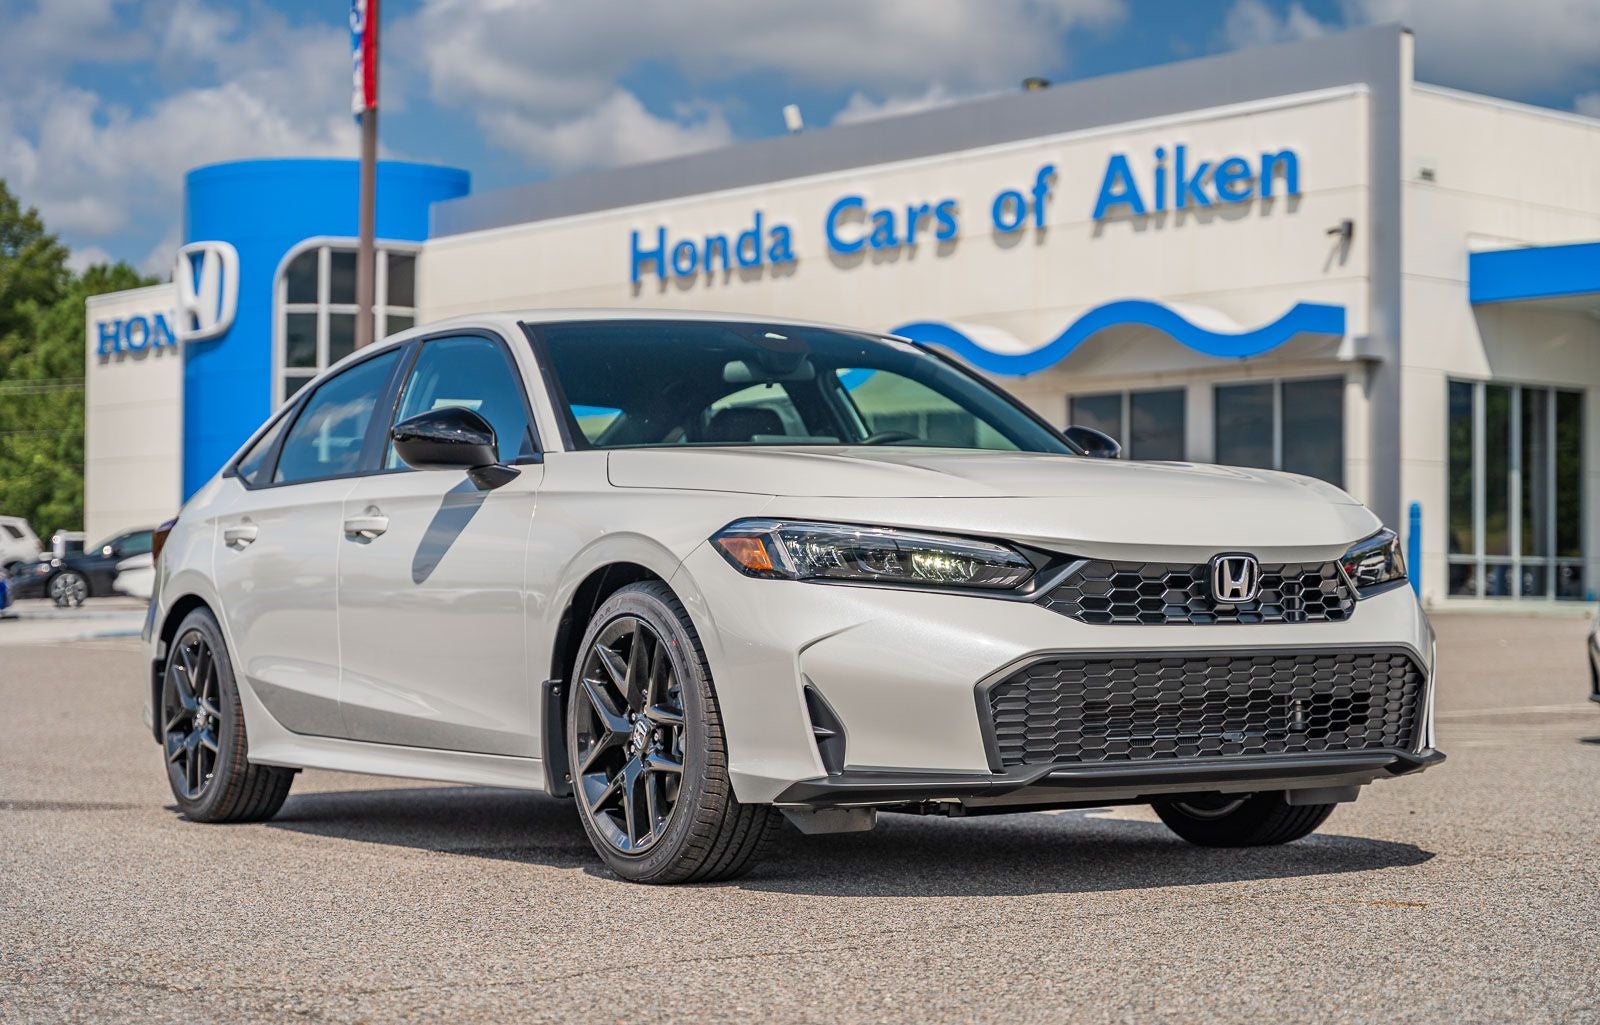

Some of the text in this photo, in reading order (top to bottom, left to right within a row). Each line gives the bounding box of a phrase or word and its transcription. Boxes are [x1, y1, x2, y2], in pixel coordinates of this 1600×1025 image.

[630, 144, 1301, 284] Honda Cars of Aiken
